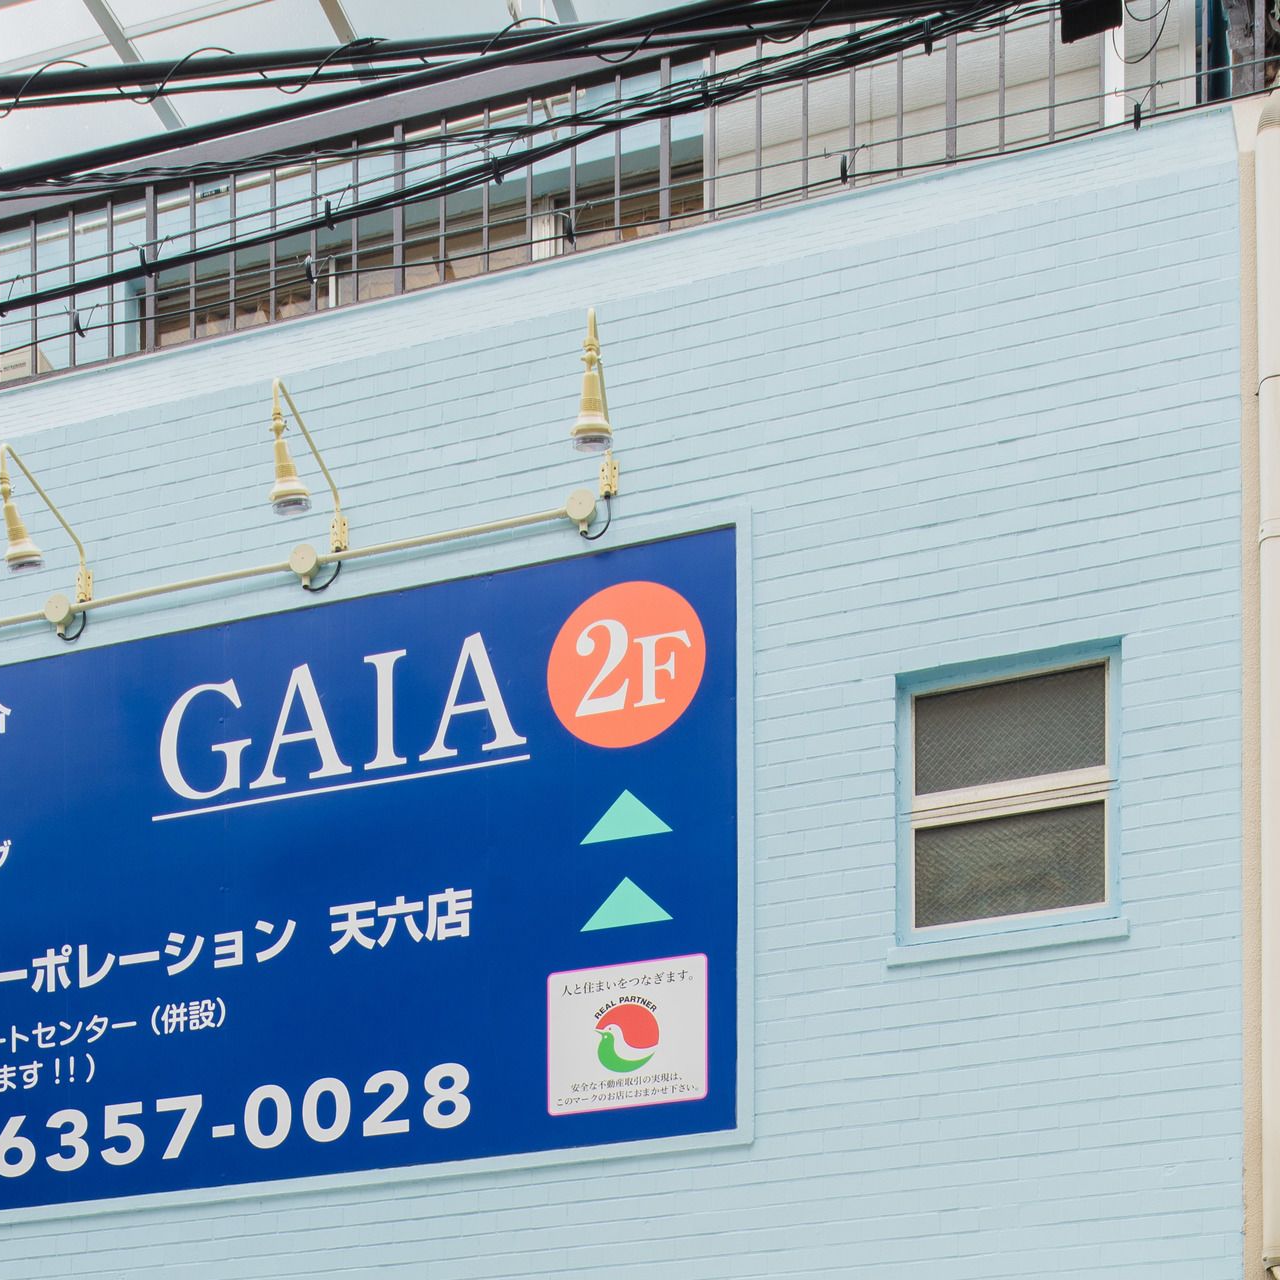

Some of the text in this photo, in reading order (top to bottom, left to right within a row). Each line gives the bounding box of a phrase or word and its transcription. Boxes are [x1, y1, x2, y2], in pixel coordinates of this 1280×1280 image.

[574, 618, 691, 718] 2F
[159, 631, 527, 800] GAIA
[329, 888, 473, 955] 天六店
[561, 969, 694, 997] 人と住まいをつなぎます。
[594, 995, 657, 1020] REAL PARTNER
